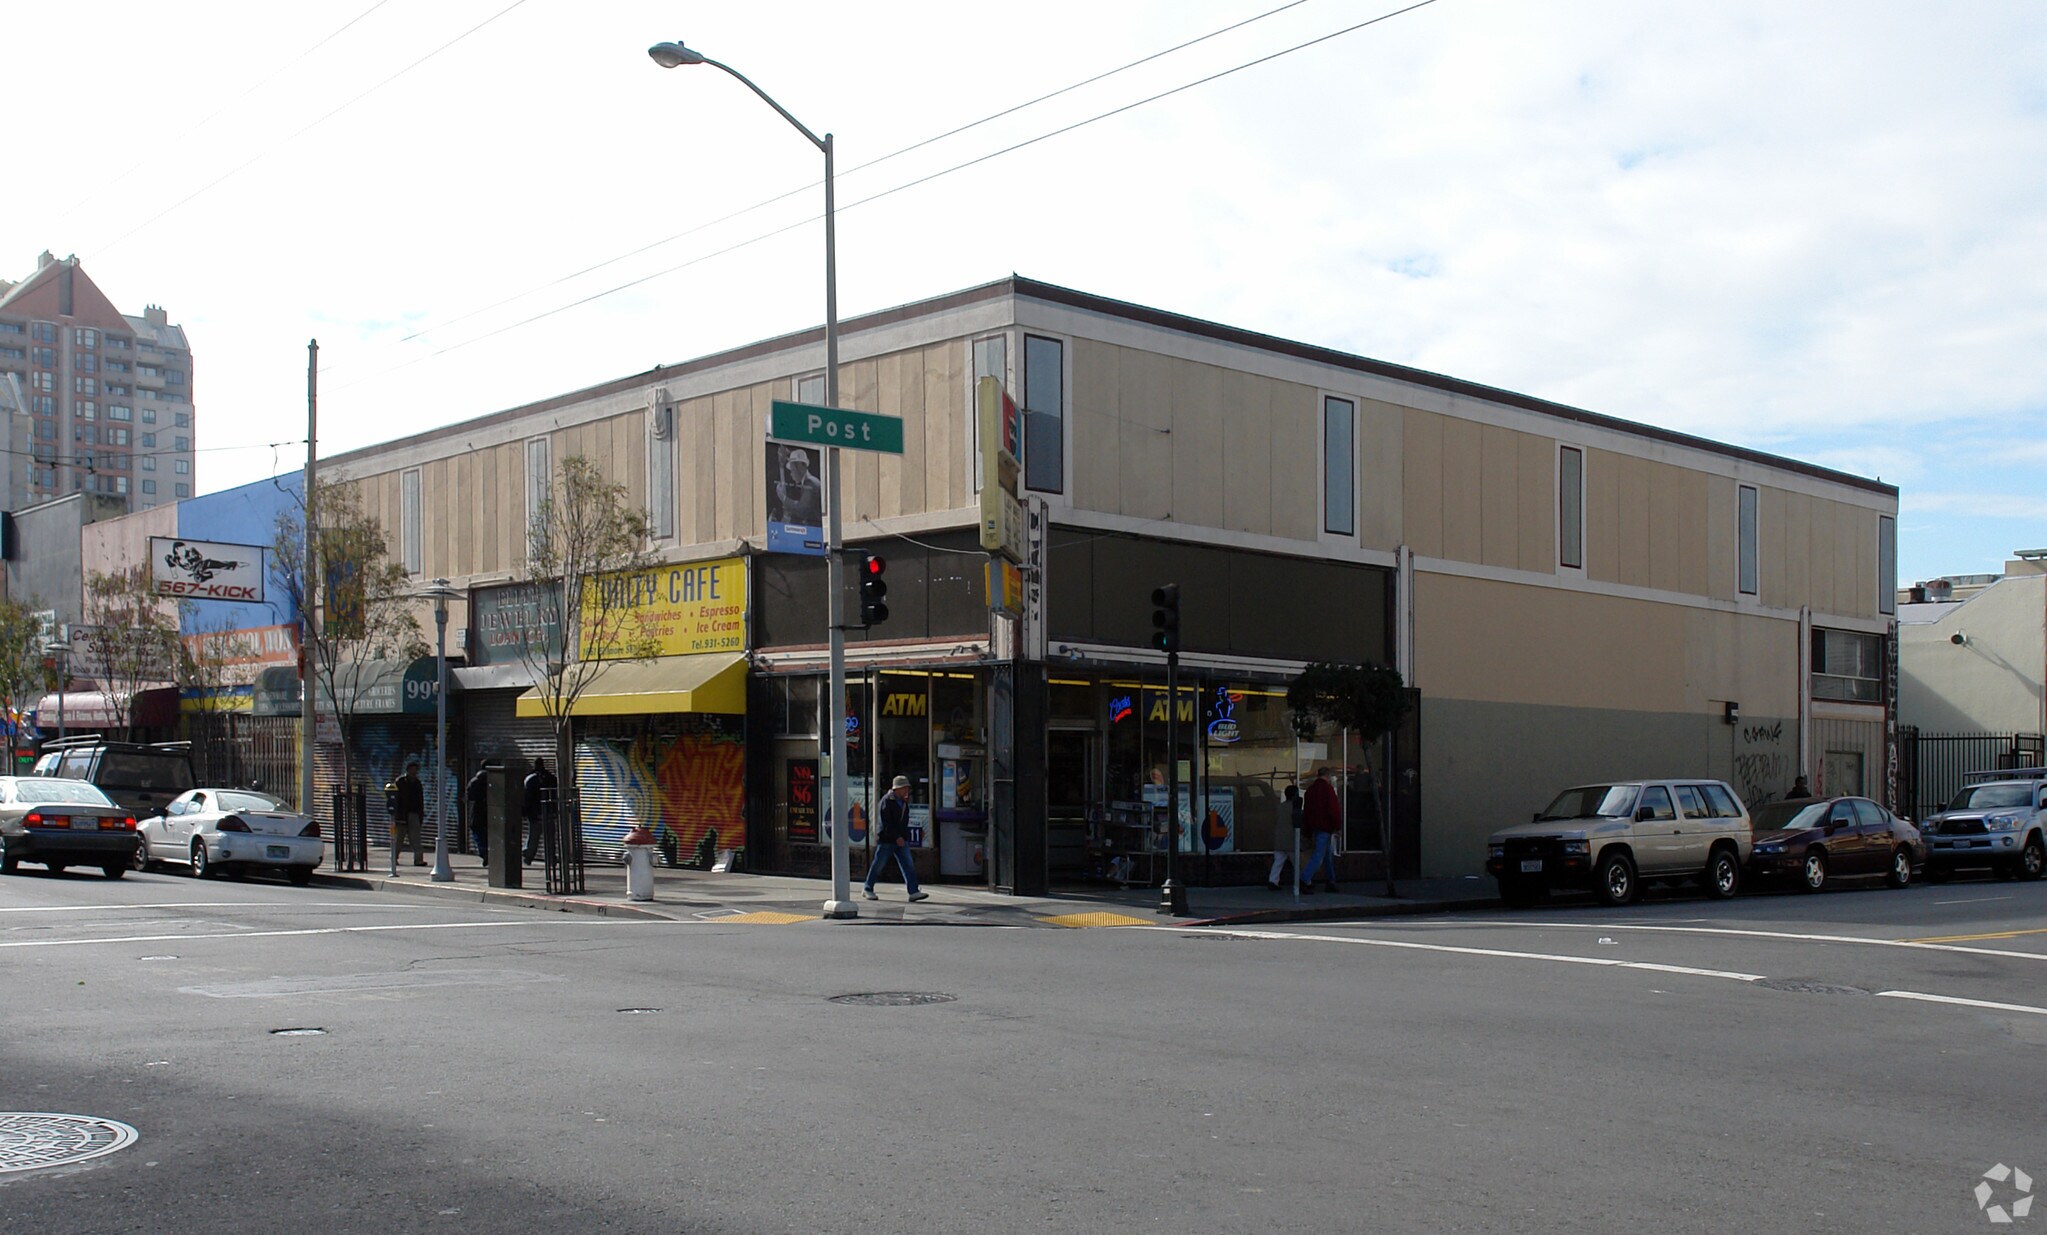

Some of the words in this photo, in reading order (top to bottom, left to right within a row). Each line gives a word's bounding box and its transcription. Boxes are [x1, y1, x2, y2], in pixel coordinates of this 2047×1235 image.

[807, 413, 871, 441] Post
[159, 579, 257, 599] 567-KICK
[668, 565, 721, 603] CAFE
[480, 607, 556, 631] JEWELRY
[700, 606, 739, 619] Espresso
[696, 621, 709, 633] Ice
[712, 620, 740, 632] Cream
[489, 633, 520, 646] LOAN
[882, 694, 927, 715] ATM
[1212, 732, 1239, 743] LIGHT
[1217, 724, 1236, 735] BUD
[792, 786, 812, 804] 86
